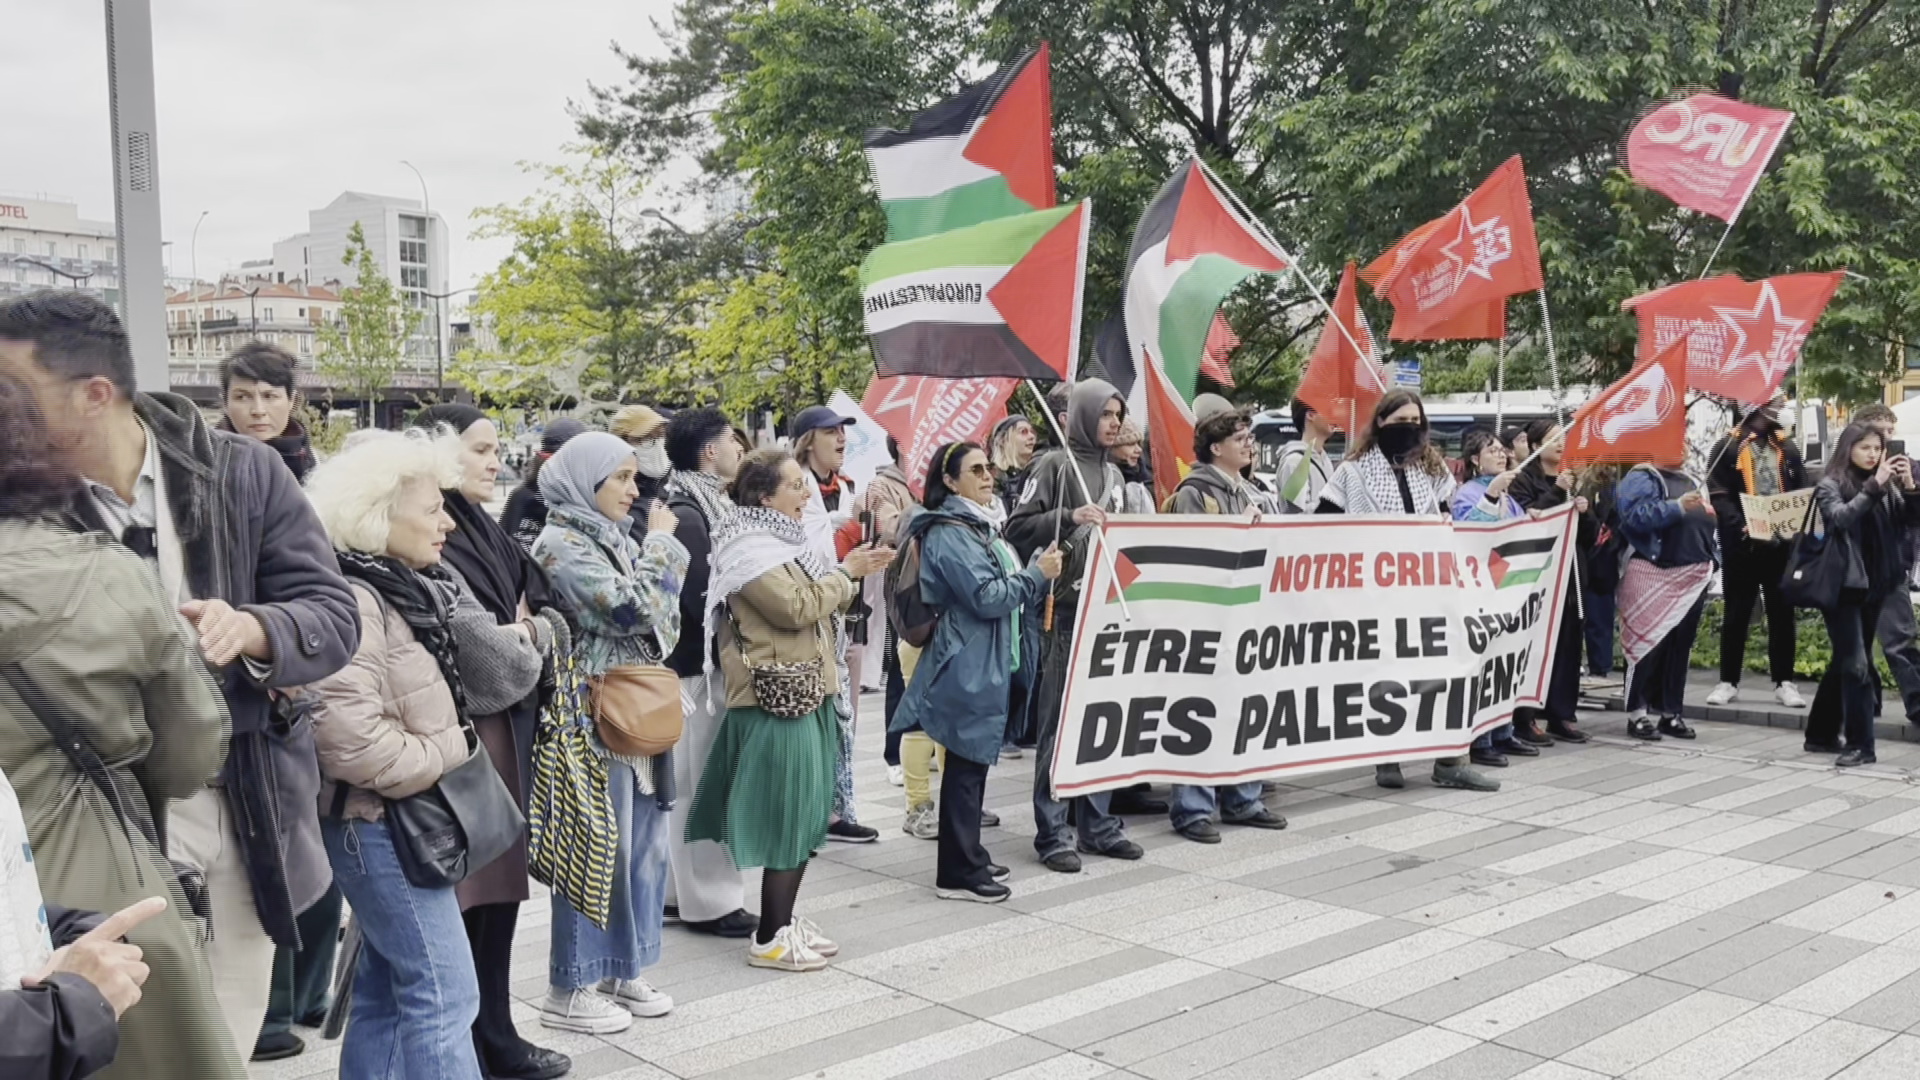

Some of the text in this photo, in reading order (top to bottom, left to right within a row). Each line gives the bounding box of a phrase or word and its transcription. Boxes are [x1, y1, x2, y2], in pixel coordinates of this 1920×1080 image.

[866, 283, 982, 313] EUROPALESTINE
[1269, 552, 1364, 593] NOTRE
[1088, 622, 1222, 679] ÊTRE
[1235, 619, 1381, 675] CONTRE
[1394, 616, 1448, 659] LE
[1076, 696, 1217, 766] DES
